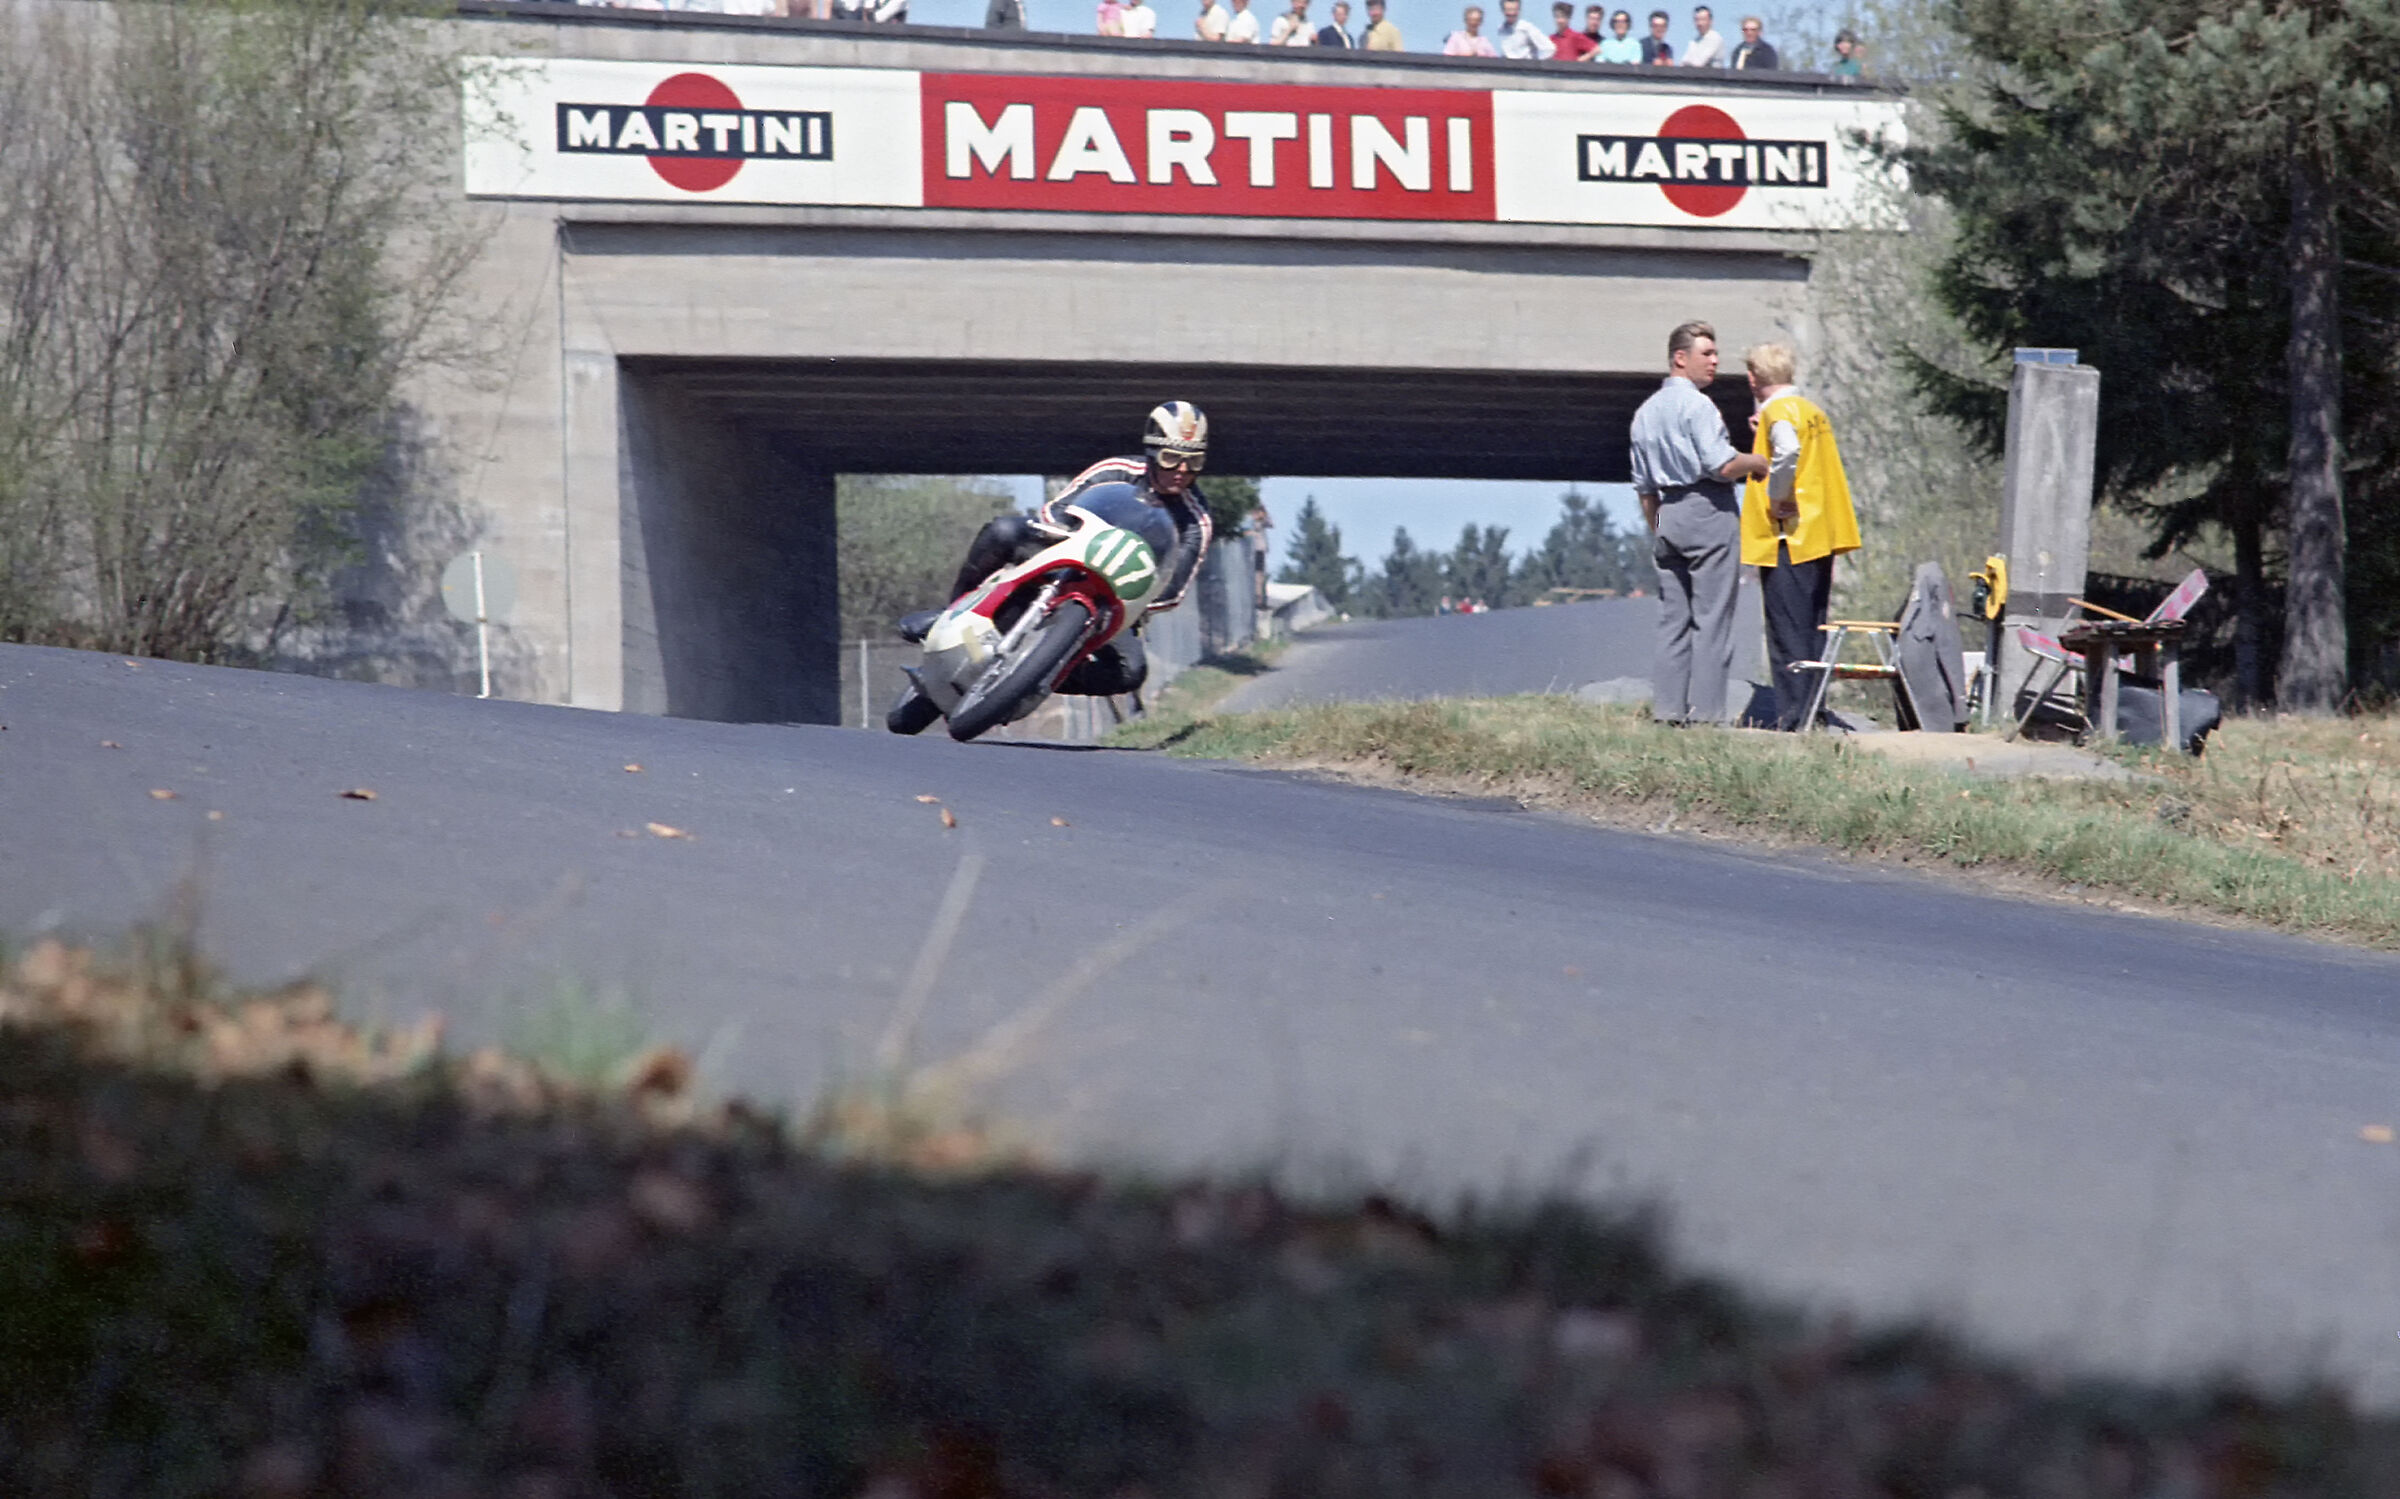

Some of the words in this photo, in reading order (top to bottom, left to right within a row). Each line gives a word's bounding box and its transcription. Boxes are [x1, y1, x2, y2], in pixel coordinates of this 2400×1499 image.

[566, 108, 824, 154] MARTINI
[944, 101, 1474, 192] MARTINI
[1586, 140, 1819, 183] MARTINI
[1090, 529, 1156, 586] 117
